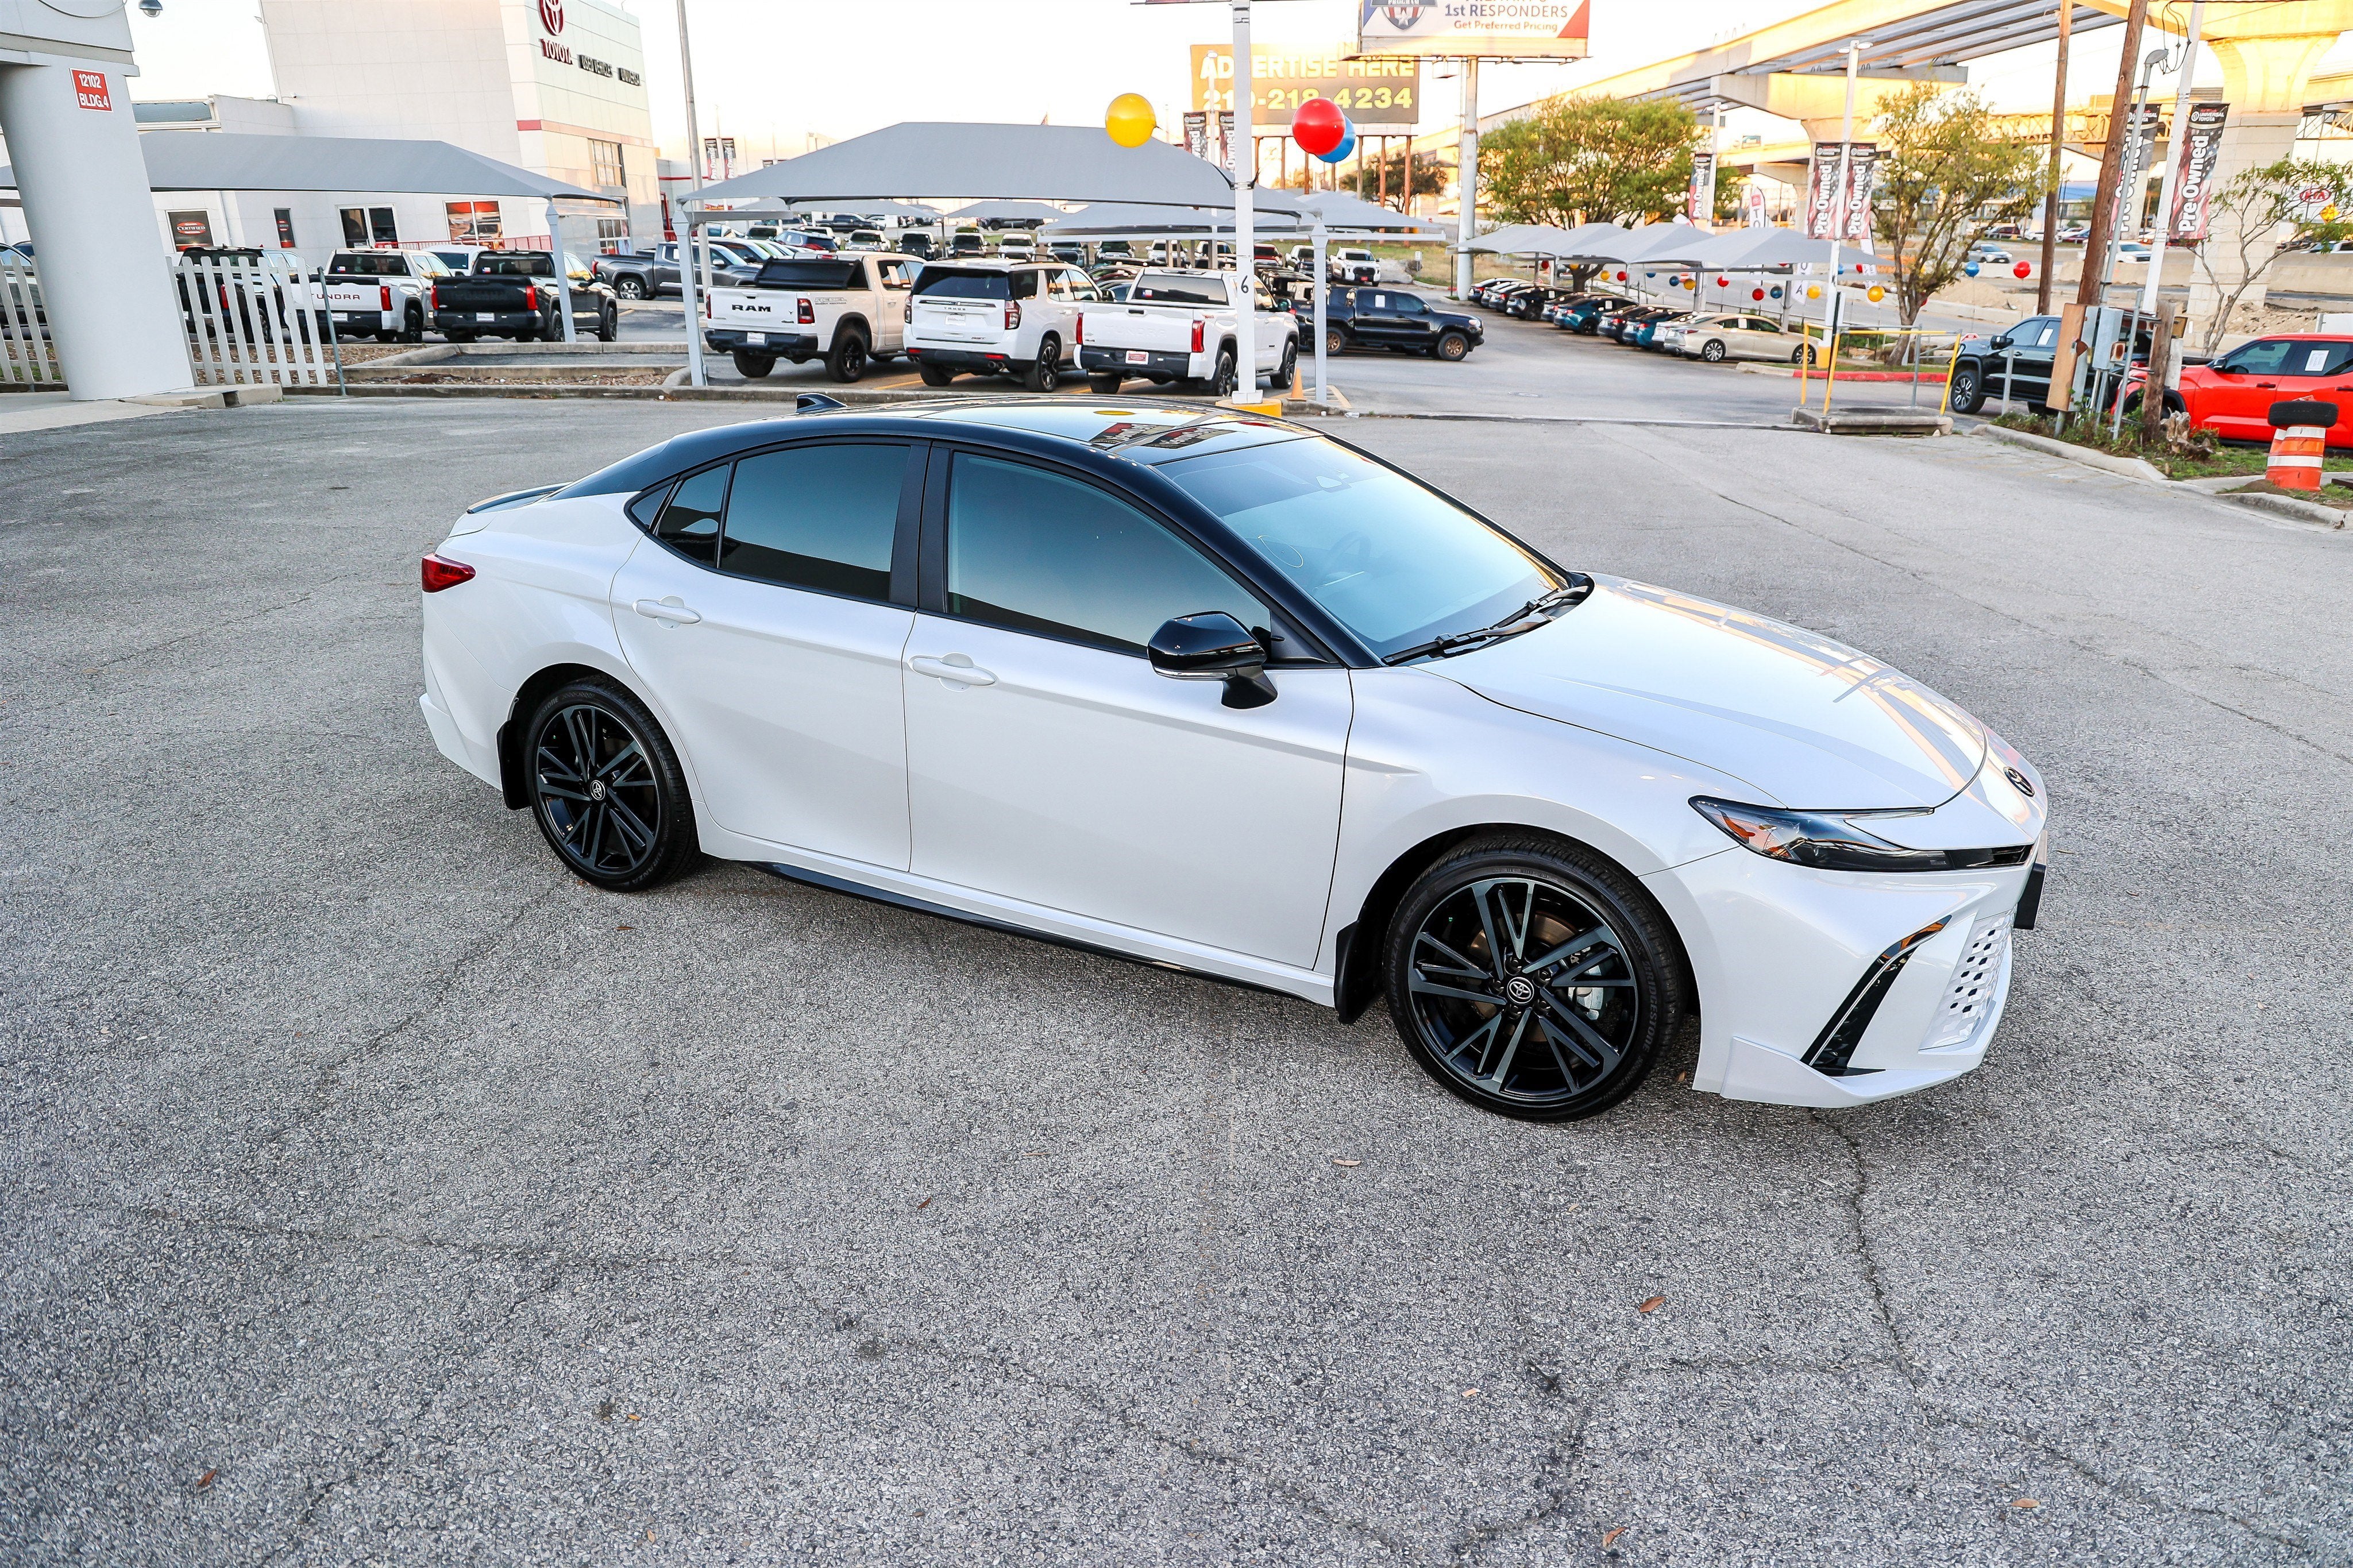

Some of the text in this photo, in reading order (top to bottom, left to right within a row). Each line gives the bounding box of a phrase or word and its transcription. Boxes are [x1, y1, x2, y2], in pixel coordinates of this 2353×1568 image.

[1445, 3, 1567, 17] 1st RESPONDERS
[1454, 21, 1558, 32] Get Preferred Pricing
[541, 38, 573, 64] TOYOTA
[1200, 55, 1414, 79] ADERTISE HERE
[78, 74, 102, 88] 12102
[2182, 135, 2210, 199] Owned
[1694, 168, 1706, 202] Owned
[1815, 164, 1833, 211] Owned
[1849, 165, 1866, 211] Owned
[1692, 201, 1703, 218] Pre
[2178, 202, 2197, 231] Pre
[1814, 212, 1829, 234] Pre
[1847, 212, 1862, 234] Pre
[1241, 275, 1249, 293] 6
[731, 304, 771, 312] RAM
[1389, 937, 1403, 1018] TURANZA
[1642, 960, 1658, 1053] BRIDGESTONE
